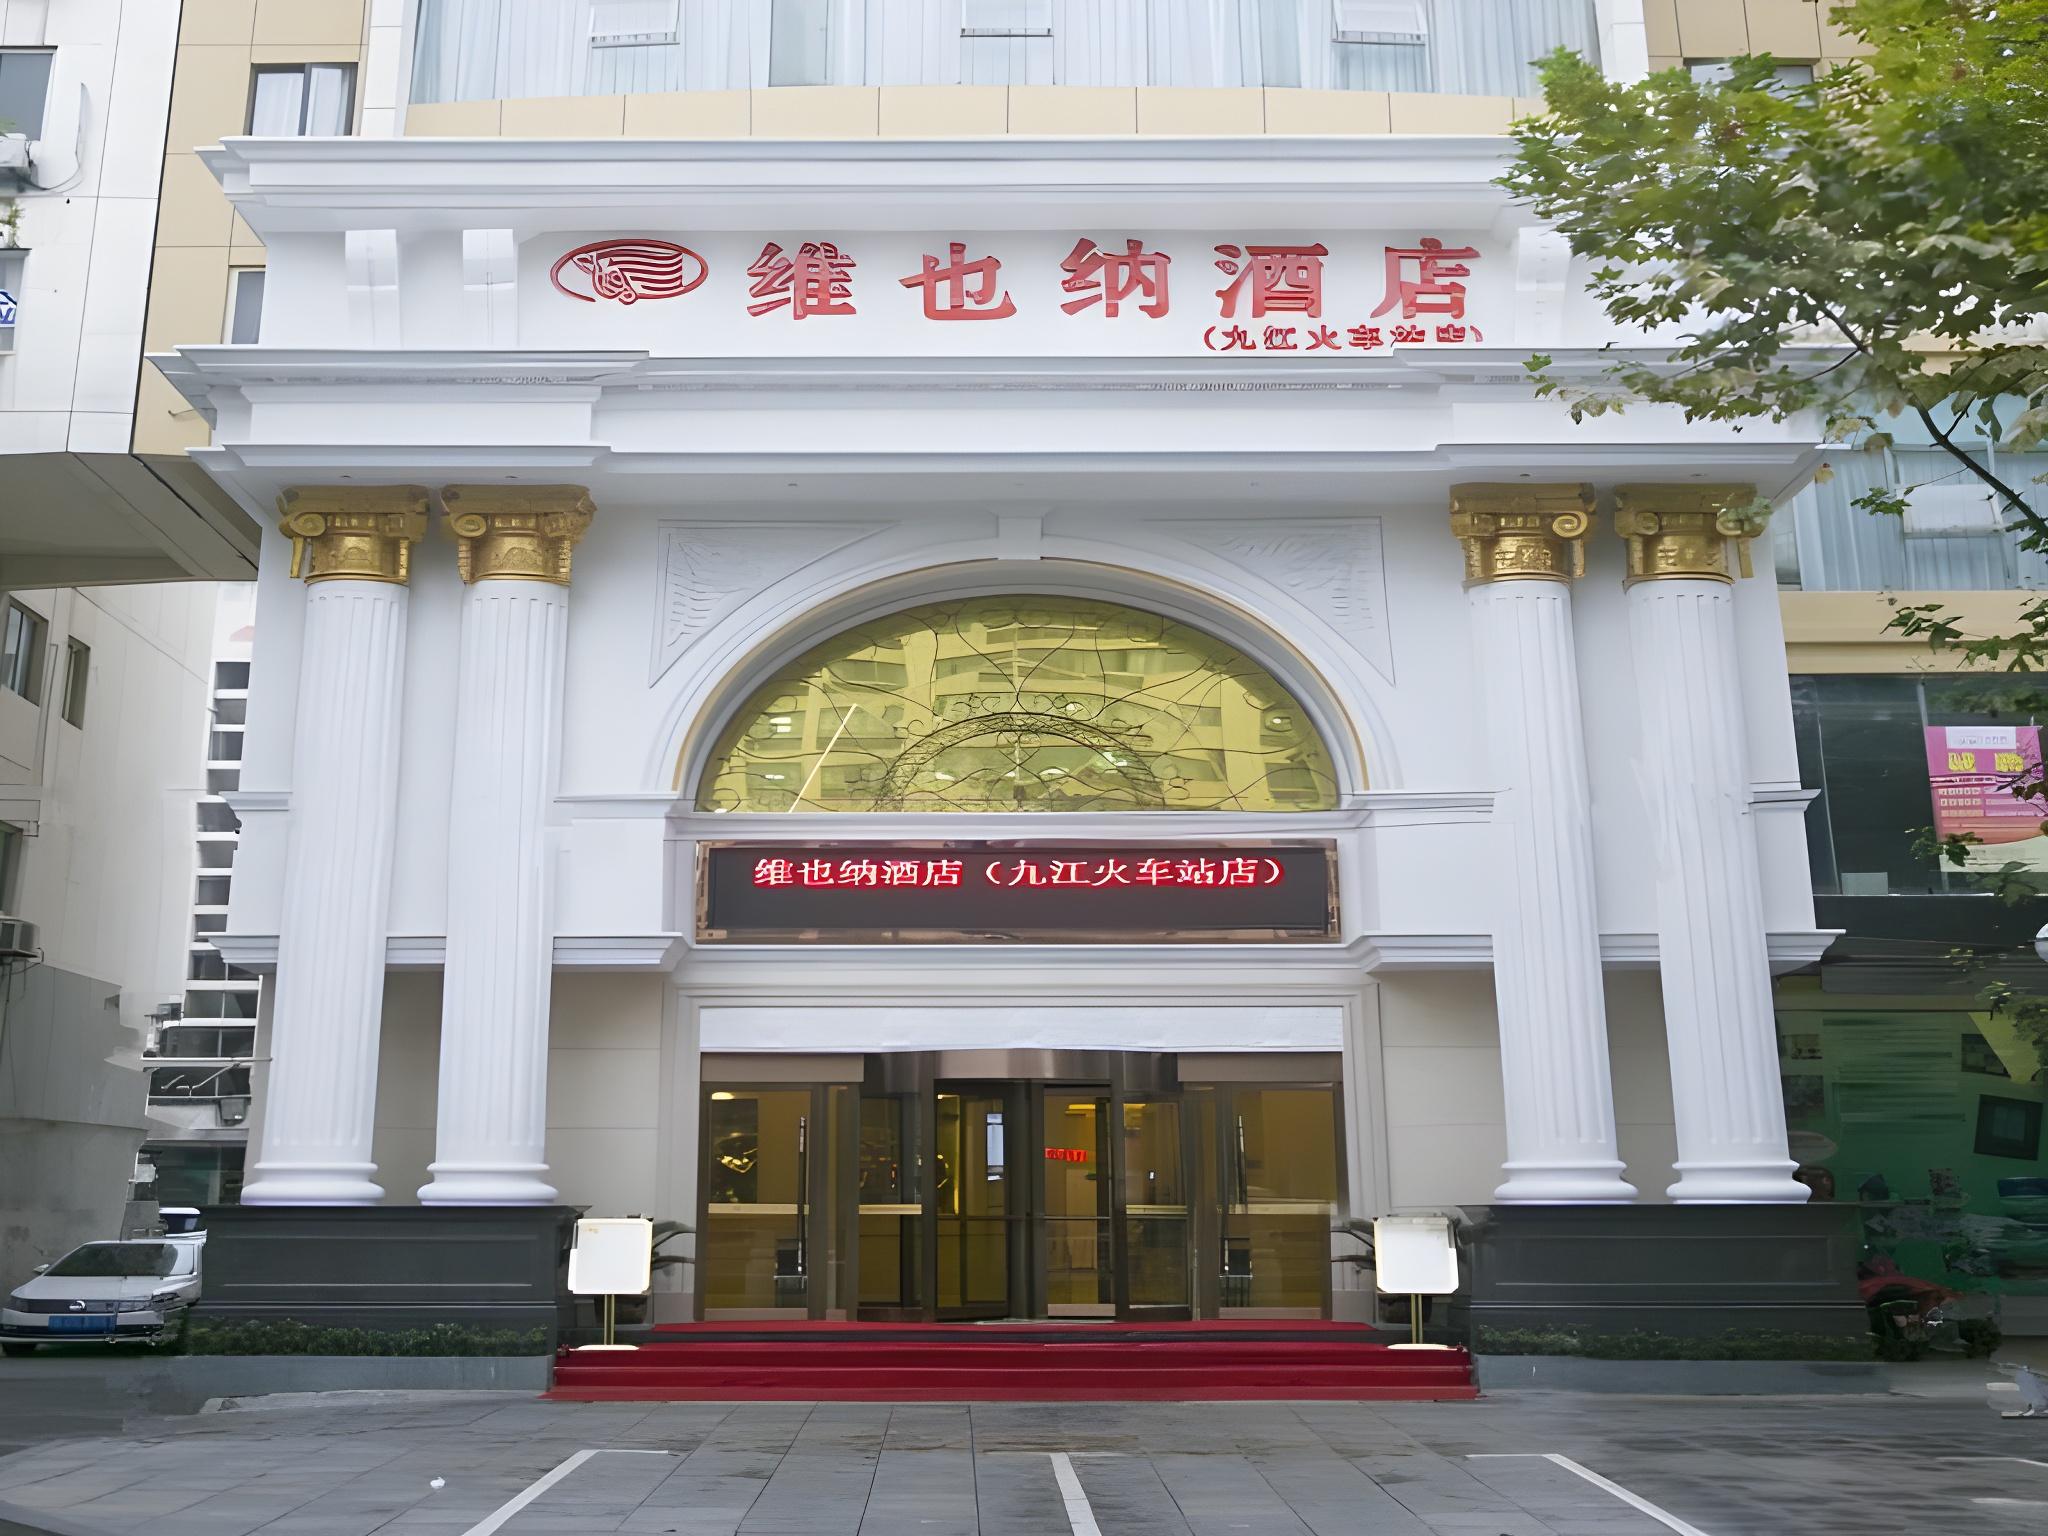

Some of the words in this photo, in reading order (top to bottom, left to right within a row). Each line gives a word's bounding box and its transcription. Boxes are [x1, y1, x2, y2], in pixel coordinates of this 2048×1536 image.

[747, 239, 1478, 320] 维也纳酒店
